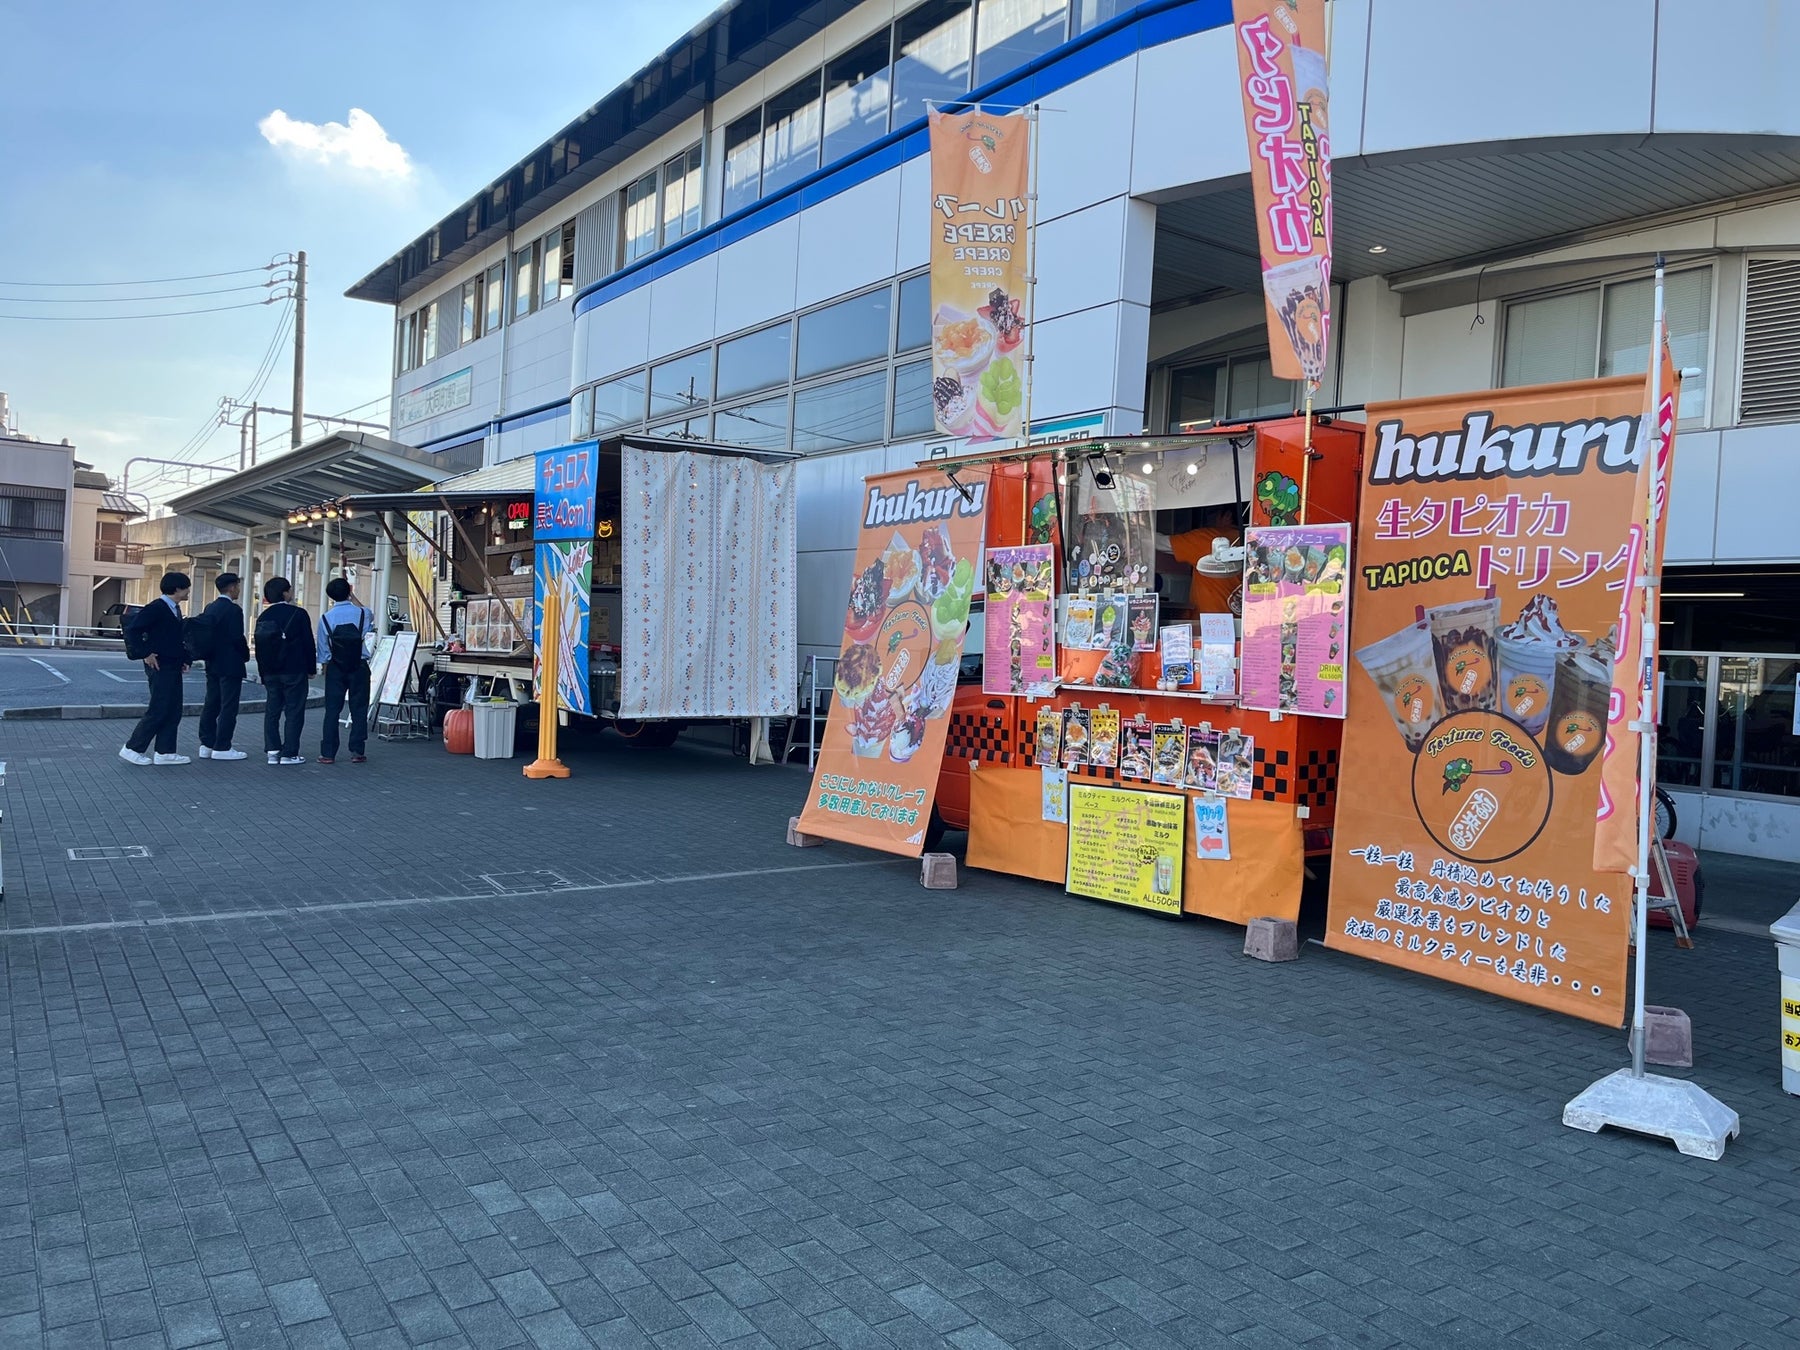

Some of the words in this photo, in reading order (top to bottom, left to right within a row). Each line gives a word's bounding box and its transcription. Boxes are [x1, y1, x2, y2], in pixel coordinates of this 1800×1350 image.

[1369, 411, 1642, 485] hukuru
[542, 450, 590, 493] チュロス
[507, 502, 530, 520] OPEN
[864, 479, 986, 529] hukuru
[1375, 491, 1571, 540] 生タピオカ
[1258, 533, 1334, 546] グランドメニュー
[1363, 549, 1472, 591] TAPIOCA
[1320, 664, 1343, 677] DRINK
[1426, 727, 1485, 758] Fortune
[1490, 728, 1537, 769] Foods
[817, 793, 919, 826] 多数用意しております
[819, 773, 926, 805] ここにしかないクレープ
[1078, 791, 1106, 799] ミルクティー
[1111, 795, 1141, 805] ミルクベース
[1154, 831, 1170, 839] ミルク
[1349, 844, 1414, 872] 一粒一粒
[1430, 858, 1612, 914] 丹精込めてお作りした
[1143, 893, 1180, 908] ALL500円
[1395, 877, 1552, 927] 最高食感タピオカと
[1375, 900, 1569, 962] 厳選茶葉をブレンドした
